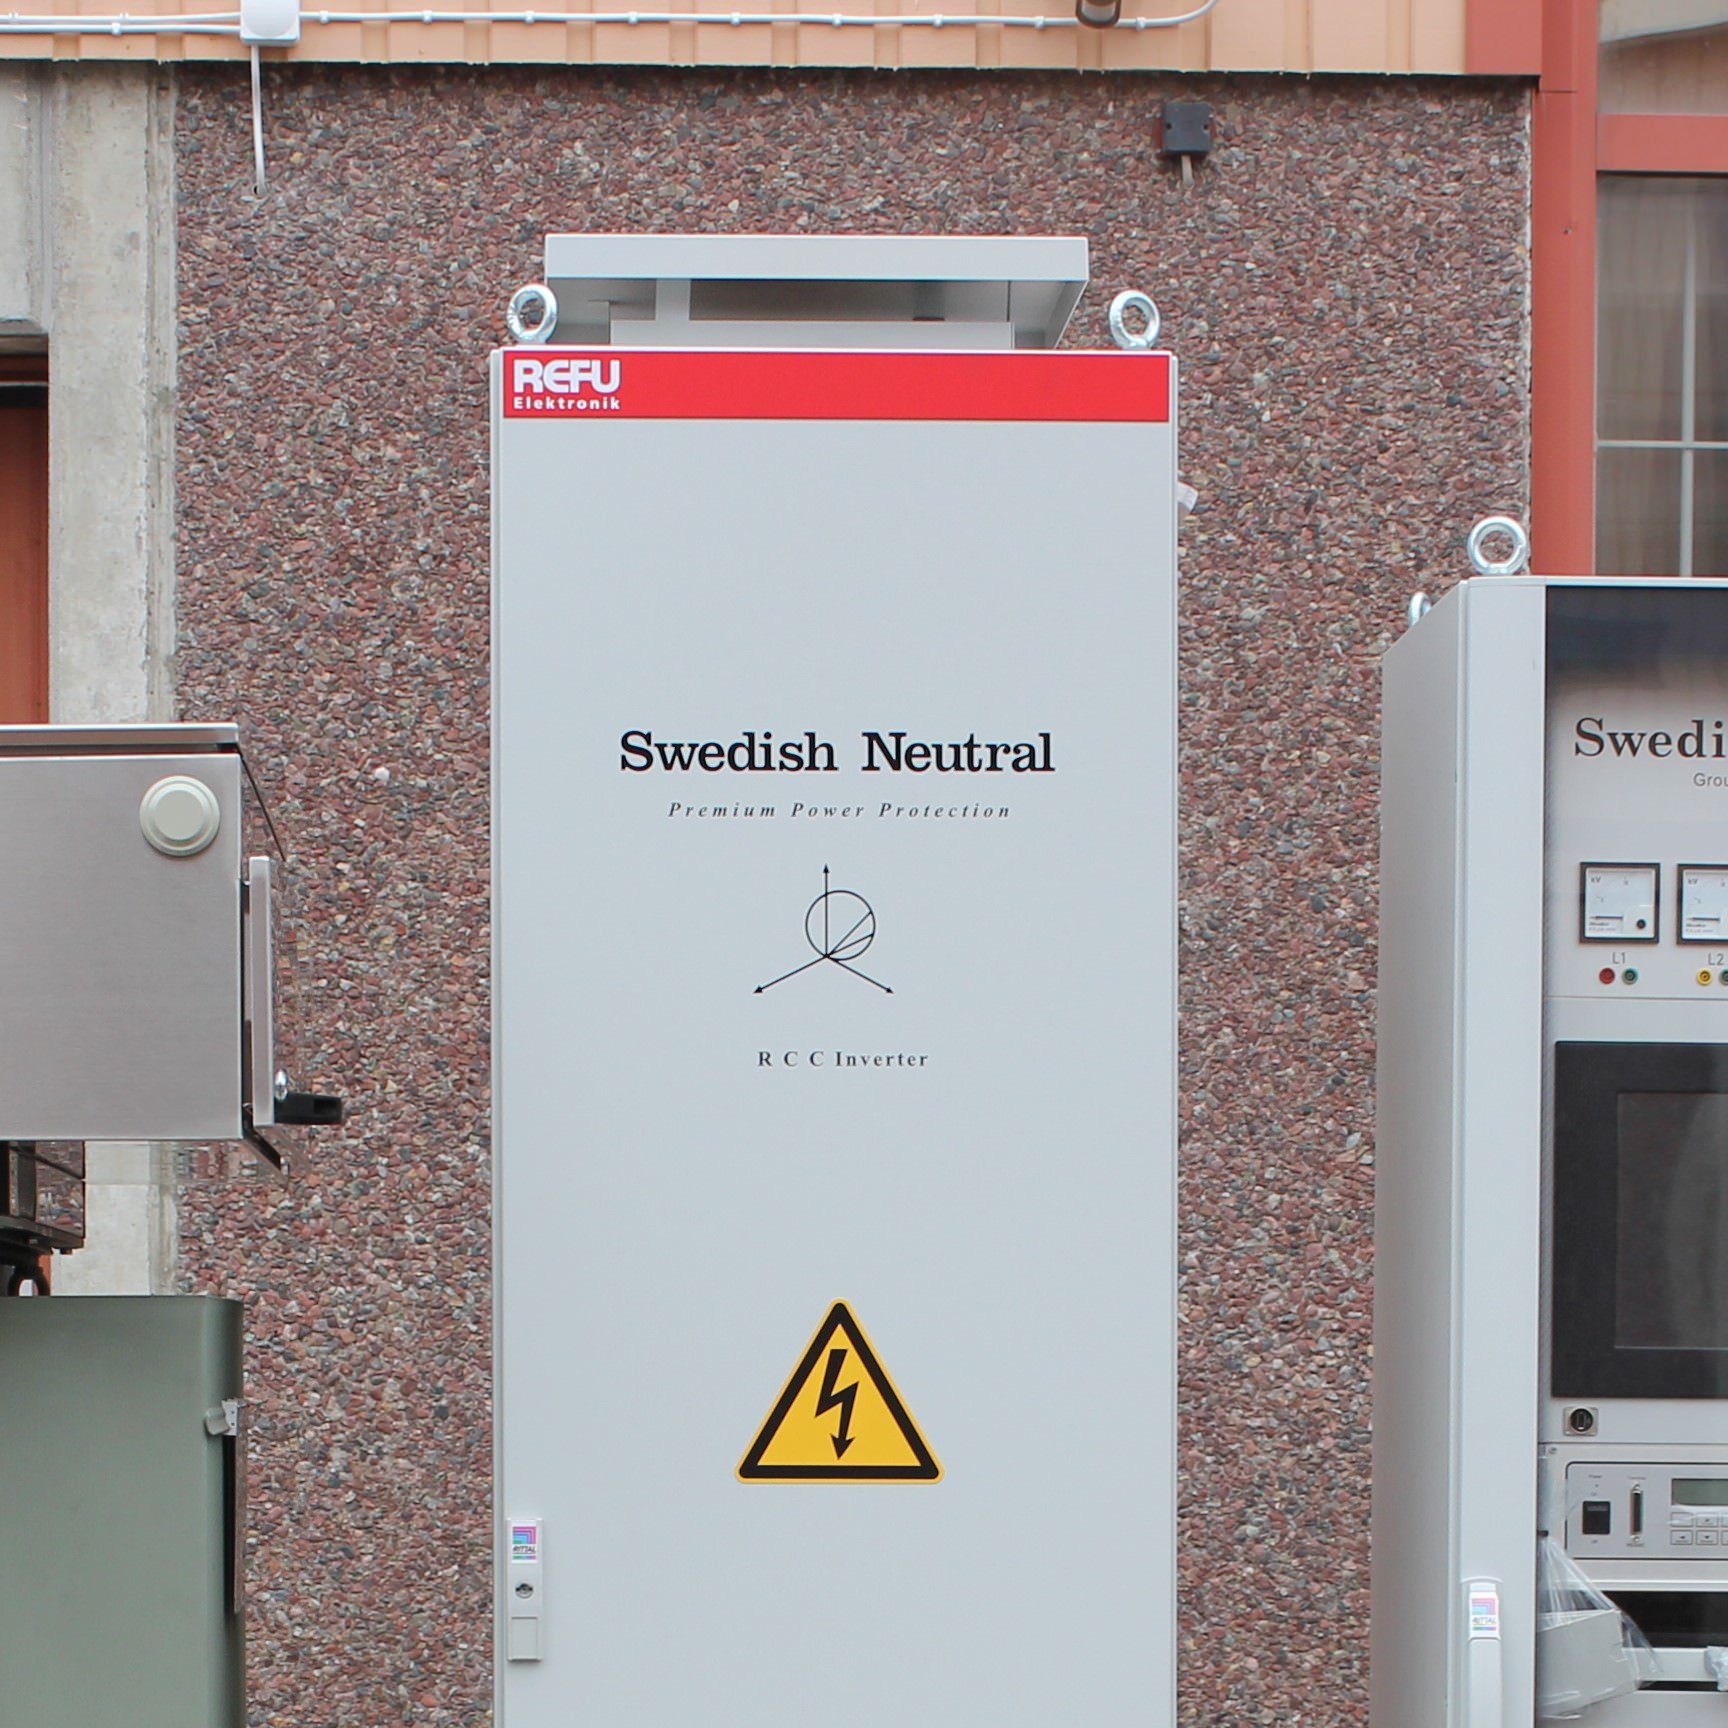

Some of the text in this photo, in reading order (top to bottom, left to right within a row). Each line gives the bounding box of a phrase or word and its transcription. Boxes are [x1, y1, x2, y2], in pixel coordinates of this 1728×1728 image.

[514, 359, 620, 393] REFU
[513, 395, 620, 410] Elektronik
[620, 730, 1056, 773] Swedish Neutral
[668, 802, 1011, 818] Premium Power Protection
[1612, 951, 1626, 965] L1
[1707, 952, 1724, 966] L2
[835, 1051, 929, 1067] Inverter
